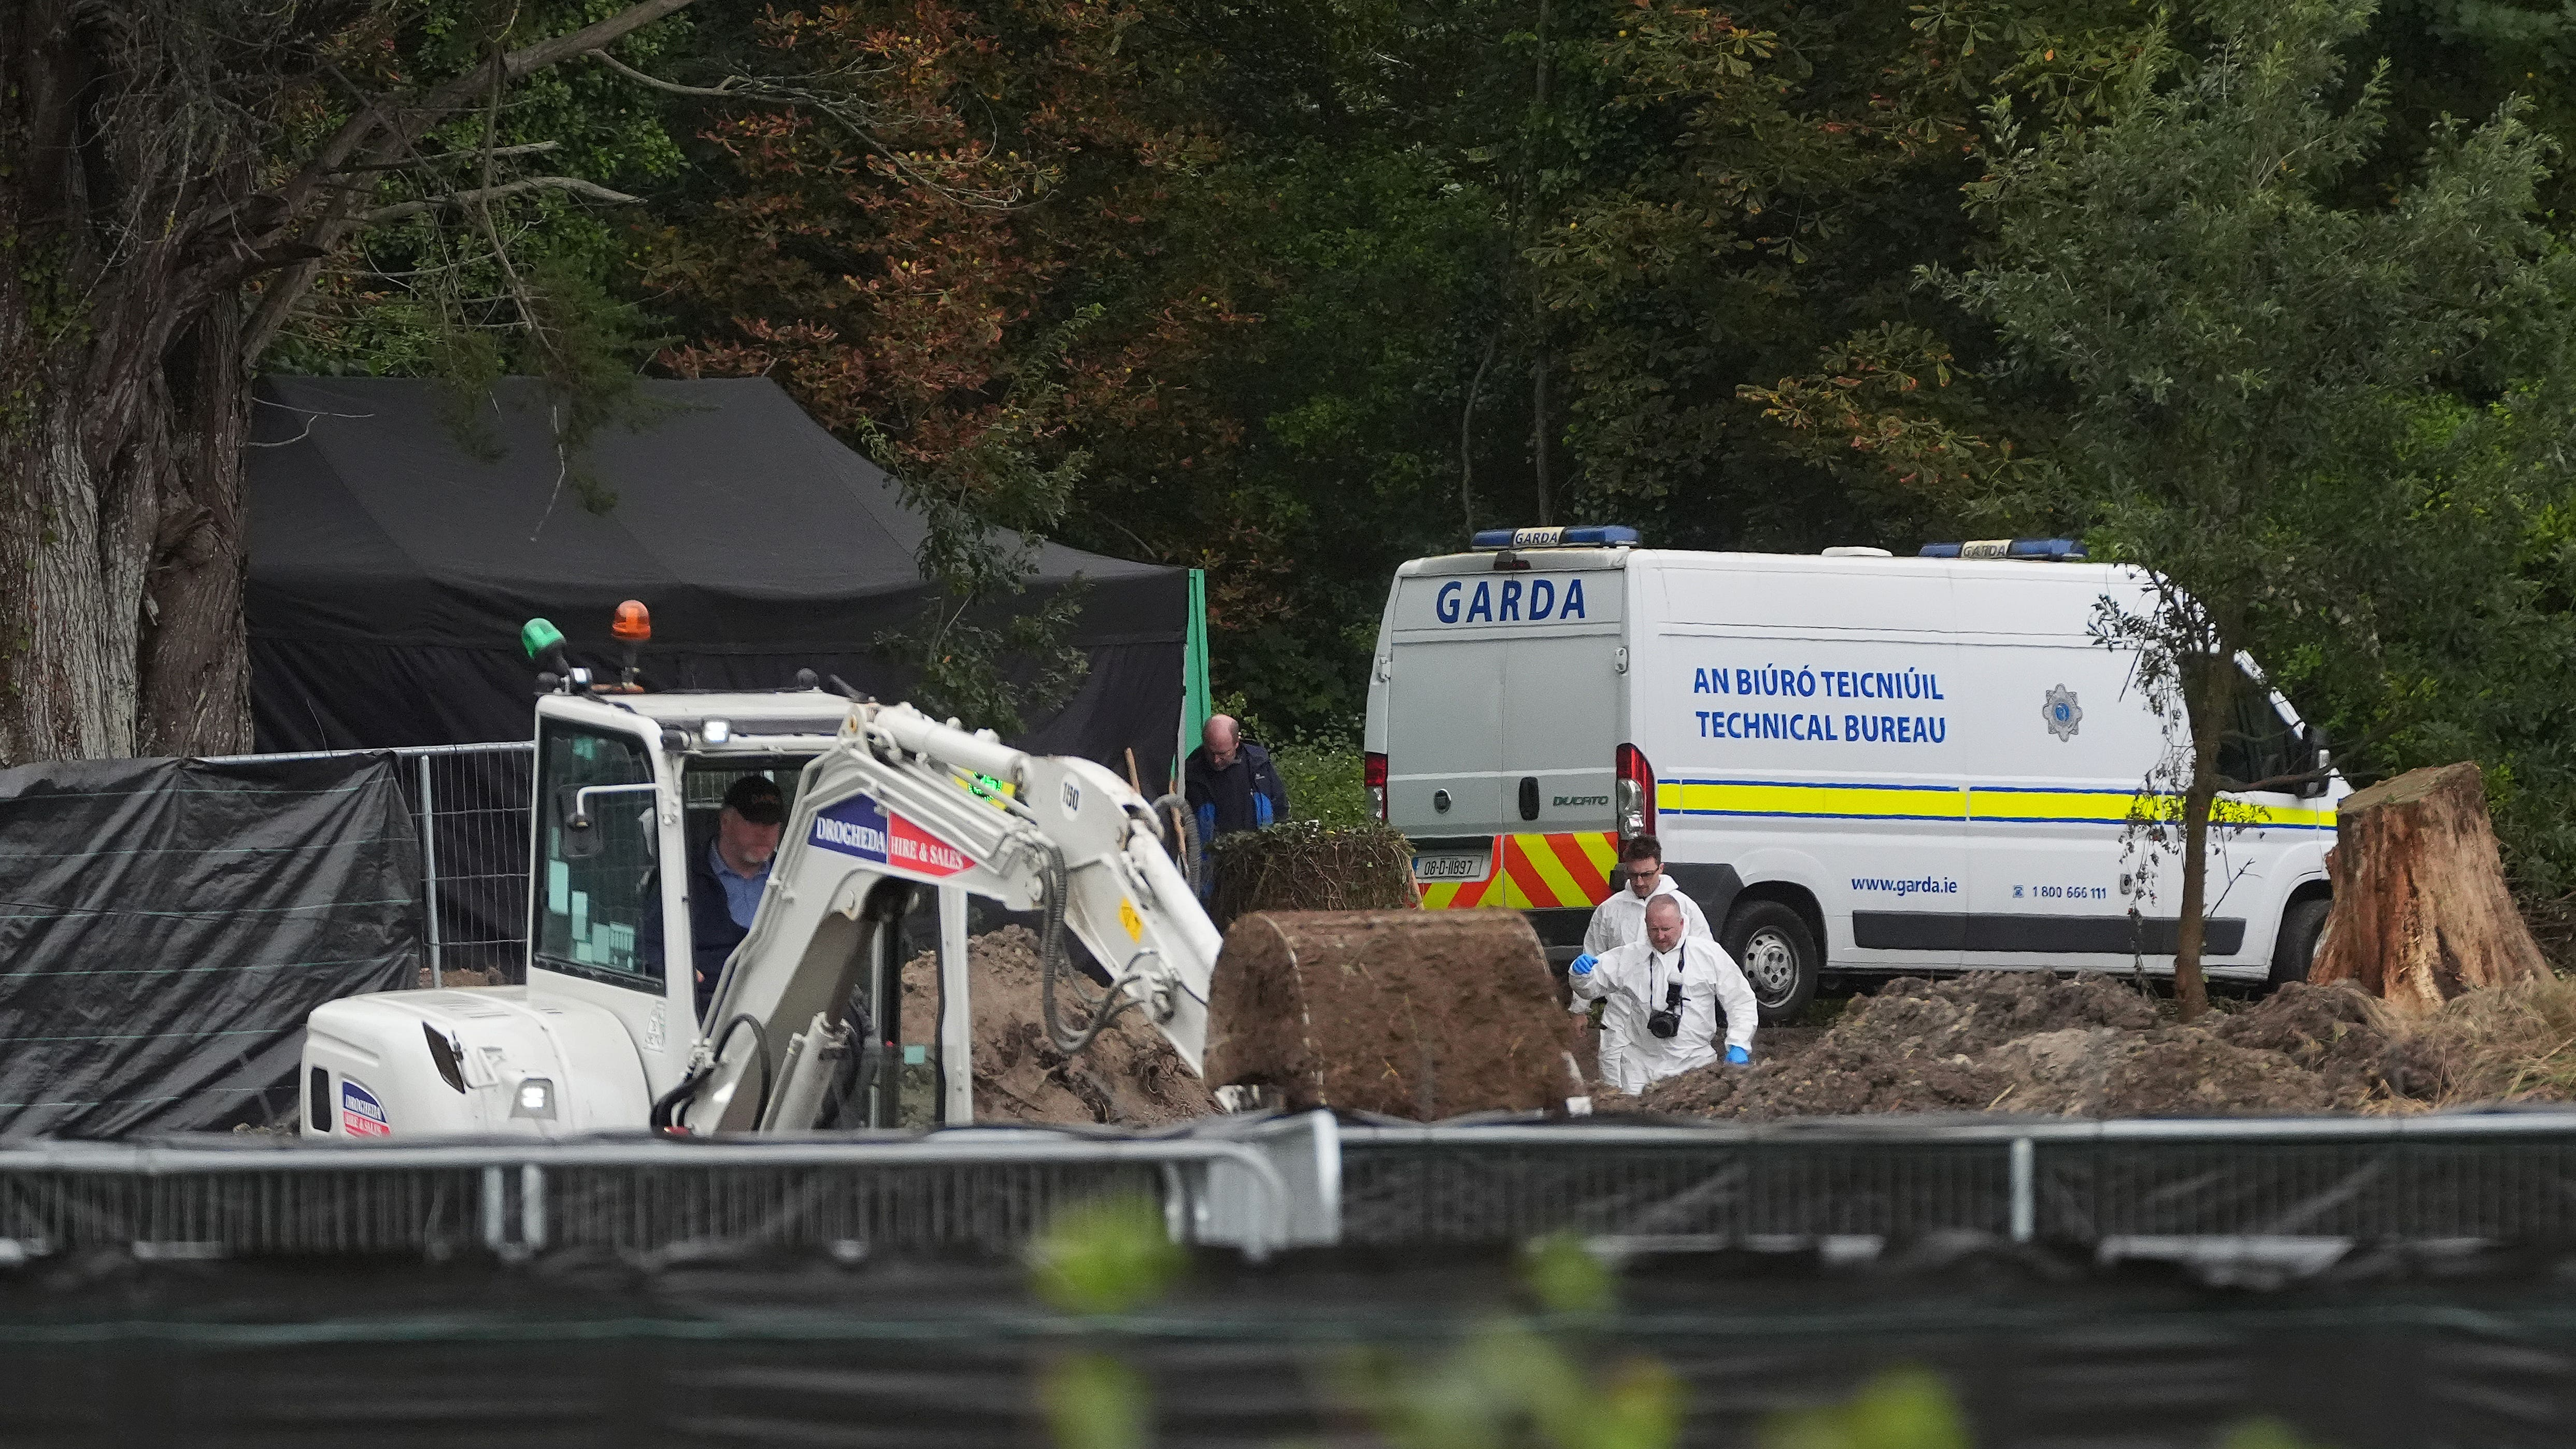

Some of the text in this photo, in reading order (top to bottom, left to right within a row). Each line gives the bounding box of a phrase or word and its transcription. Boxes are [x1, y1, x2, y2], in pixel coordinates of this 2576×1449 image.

[1515, 532, 1558, 544] GARDA
[1963, 545, 2005, 557] GARDA
[1436, 579, 1586, 624] GARDA
[1694, 663, 1944, 700] AN BIÚRÓ TEICNIÚIL
[1696, 711, 1946, 743] TECHNICAL BUREAU
[1553, 796, 1609, 806] DUCATO
[816, 816, 964, 870] DROGHEDA HIRE & SALES
[1424, 861, 1473, 875] 08-D-11897
[1852, 876, 1958, 897] www.garda.ie
[2033, 886, 2107, 899] 1 800 666 111
